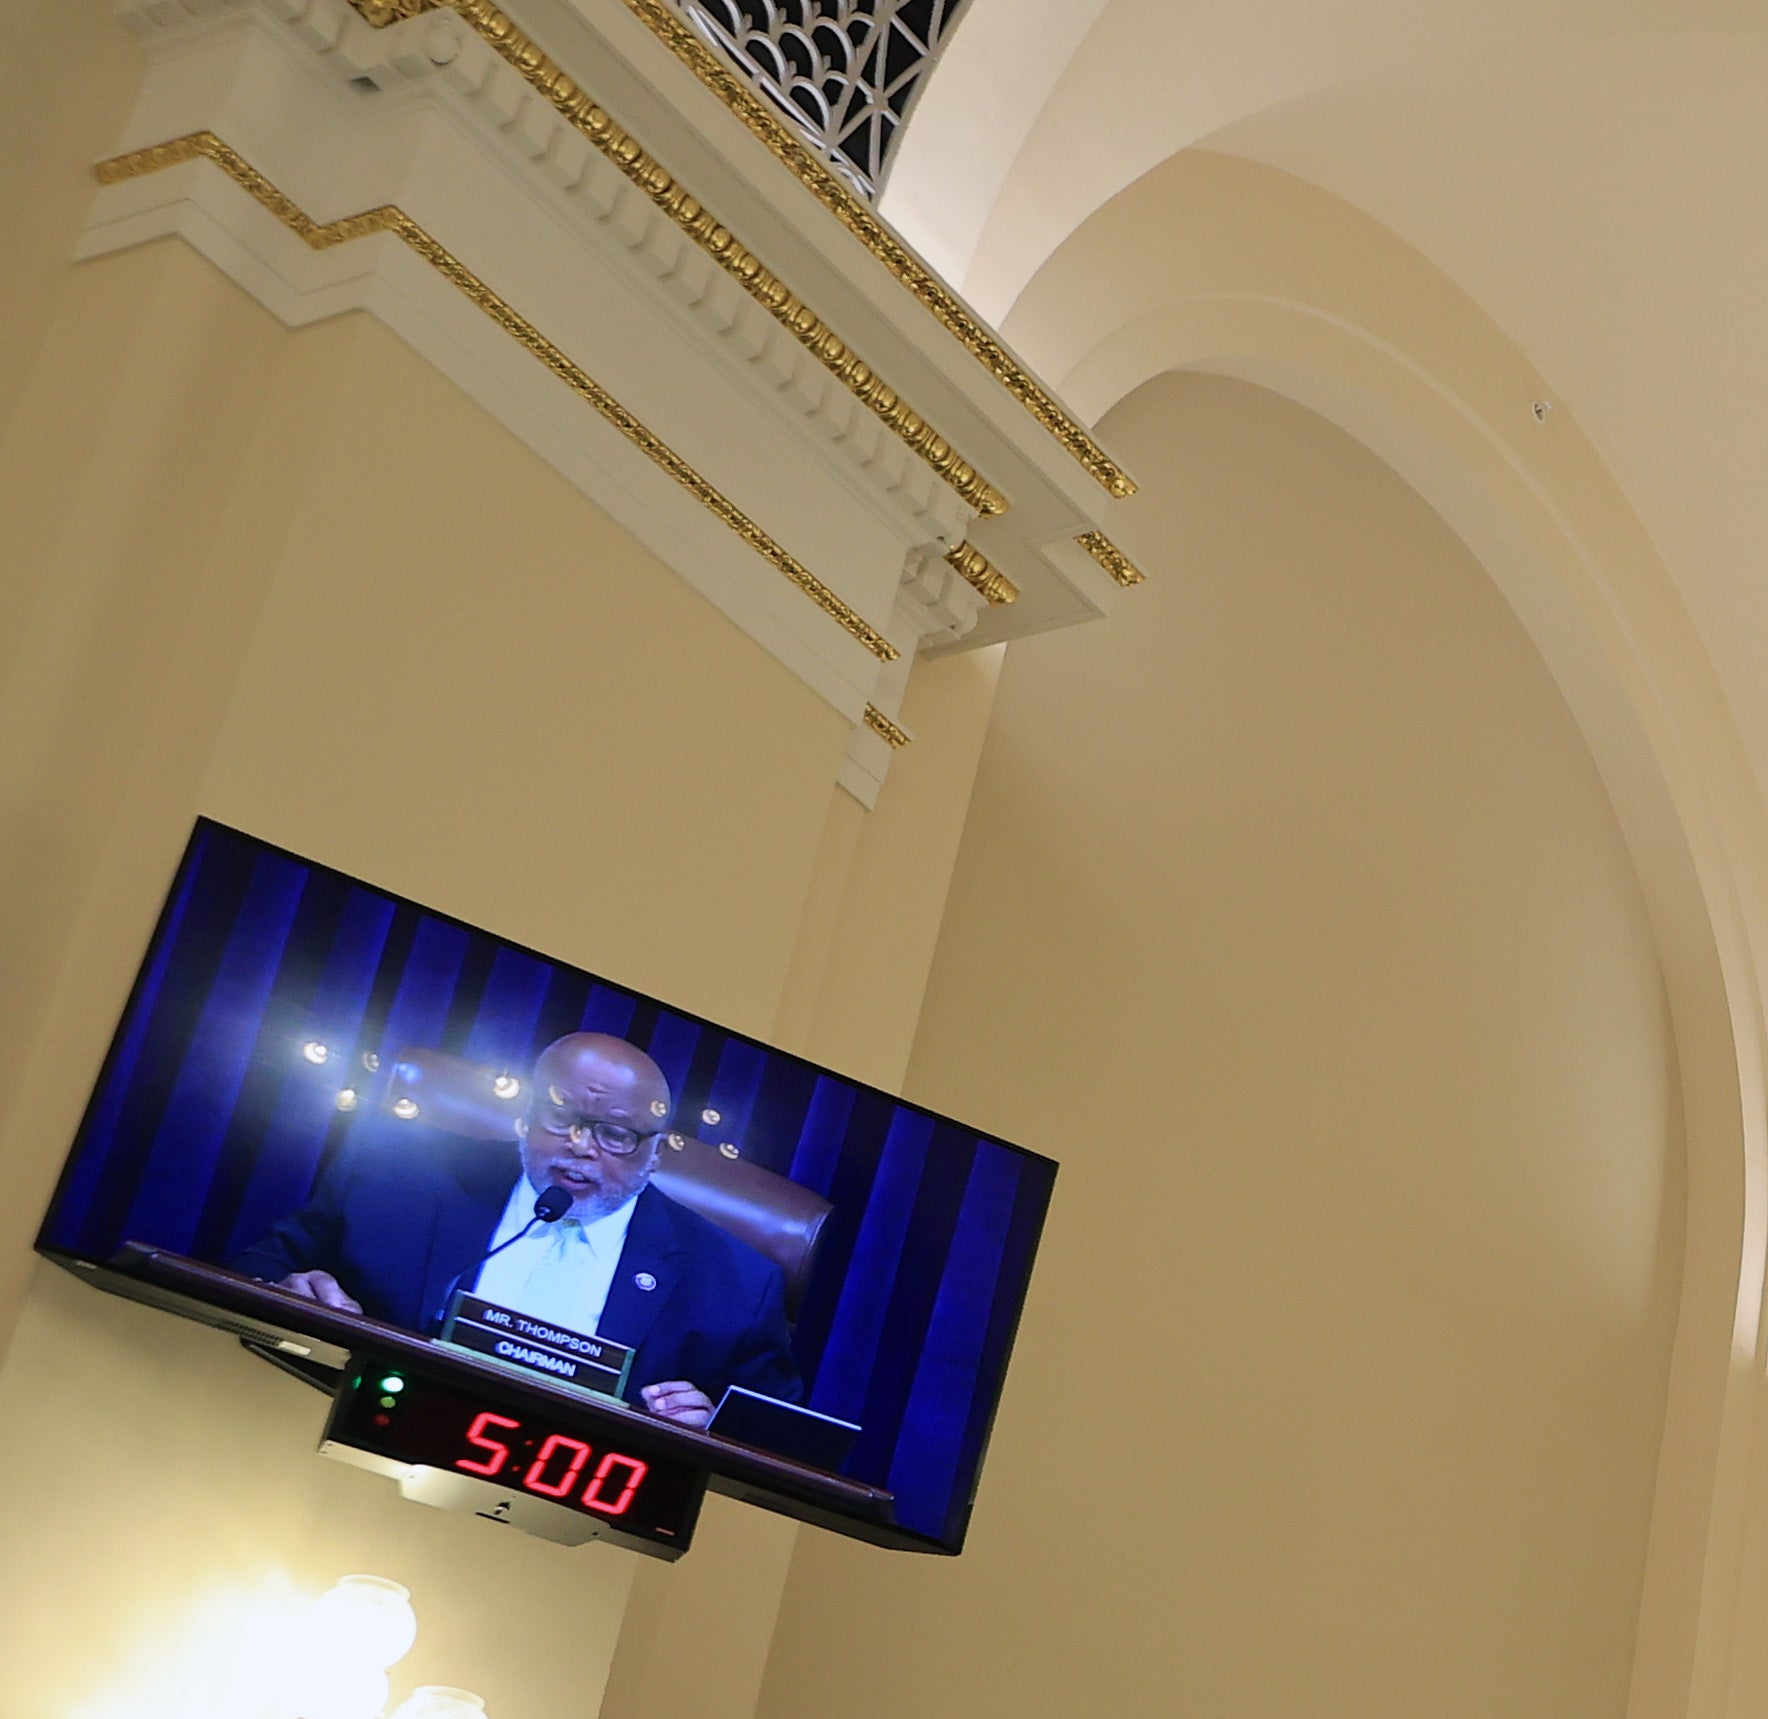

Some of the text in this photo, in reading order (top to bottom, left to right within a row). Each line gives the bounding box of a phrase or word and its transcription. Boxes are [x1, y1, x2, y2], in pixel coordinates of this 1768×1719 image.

[483, 1309, 603, 1357] MR. THOMPSON
[495, 1341, 577, 1376] CHAIRMAN
[455, 1412, 648, 1515] 5:00
